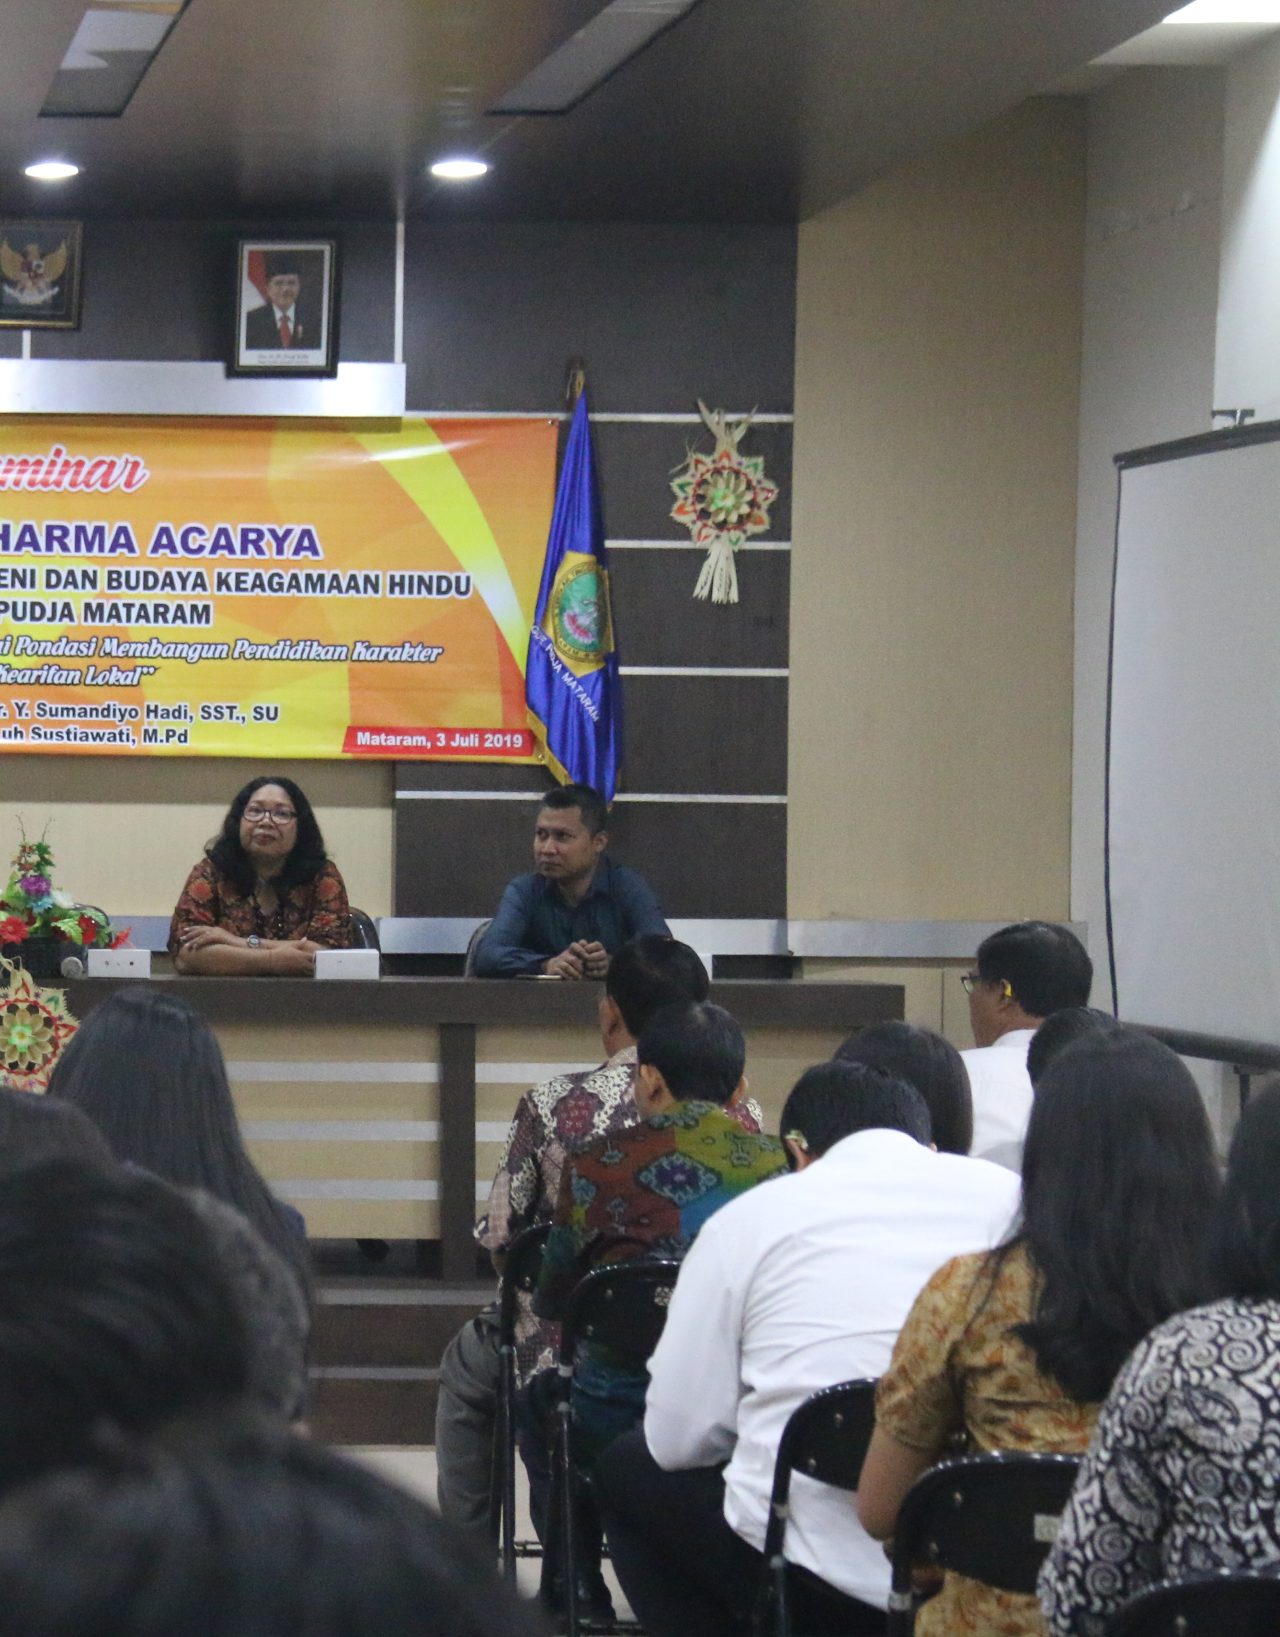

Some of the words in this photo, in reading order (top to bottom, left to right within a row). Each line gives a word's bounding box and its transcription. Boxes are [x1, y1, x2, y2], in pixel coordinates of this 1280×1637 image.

[149, 525, 321, 557] ACARYA
[45, 568, 99, 591] DAN
[106, 570, 208, 593] BUDAYA
[216, 571, 380, 595] KEAGAMAAN
[388, 573, 471, 597] HINDU
[83, 602, 211, 625] MATARAM
[14, 635, 99, 658] Pondasi
[100, 636, 229, 663] Membangun
[232, 638, 350, 661] Pendidikan
[351, 640, 443, 662] Karakter
[561, 671, 600, 722] MATARAM
[13, 702, 30, 718] Y.
[36, 702, 139, 723] Sumandiyo
[145, 704, 194, 723] Hadi,
[200, 705, 246, 724] SST.,
[252, 705, 279, 722] SU
[31, 726, 137, 745] Sustiawati,
[143, 728, 189, 744] M.Pd
[356, 731, 432, 749] Mataram,
[436, 732, 446, 747] 3
[450, 733, 480, 748] Juli
[484, 733, 523, 748] 2019
